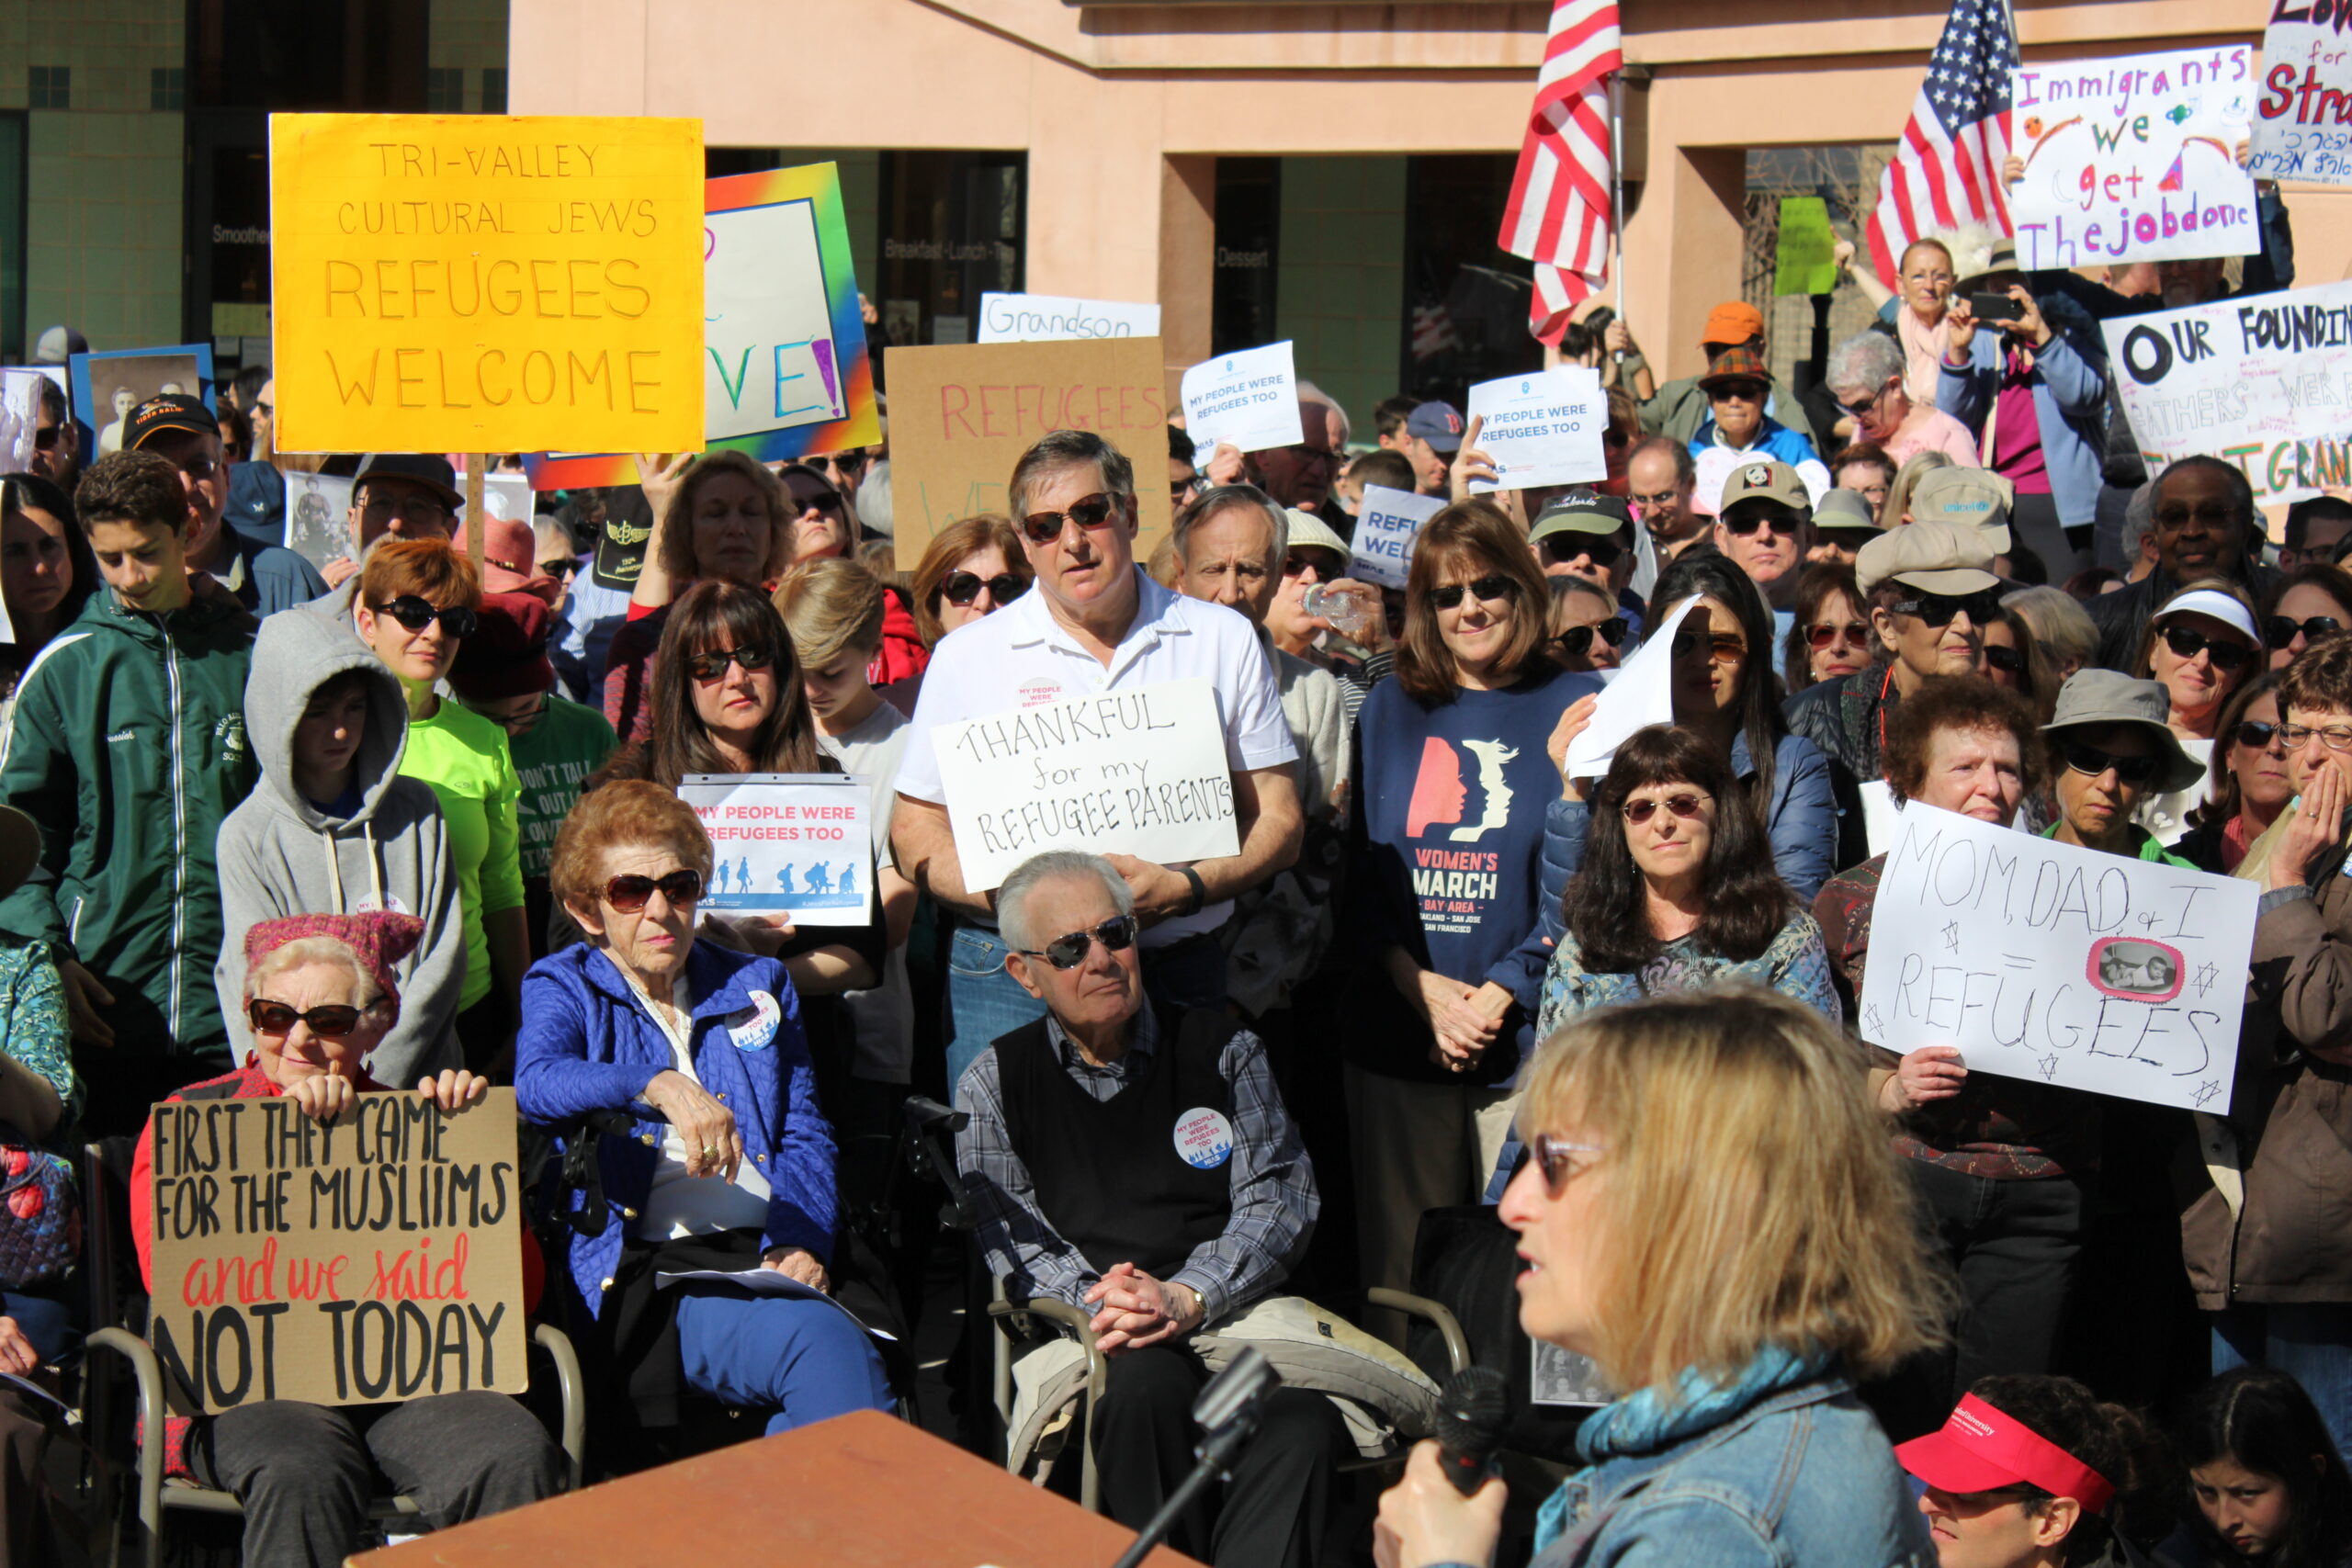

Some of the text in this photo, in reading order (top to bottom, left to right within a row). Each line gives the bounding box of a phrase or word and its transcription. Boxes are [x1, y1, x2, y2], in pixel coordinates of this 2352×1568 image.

[2268, 0, 2352, 37] Lov
[2308, 39, 2346, 65] for
[2018, 49, 2246, 118] Immigrants
[368, 143, 599, 178] TRI-VALLEY
[2078, 164, 2143, 211] get
[338, 198, 657, 238] CULTURAL JEWS
[1217, 247, 1269, 268] Dessert
[324, 258, 651, 320] REFUGEES
[987, 299, 1131, 339] Grandson
[2122, 320, 2217, 385] OUR
[324, 348, 662, 414] WELCOME
[1189, 395, 1204, 408] MY
[1204, 382, 1246, 402] PEOPLE
[1248, 374, 1284, 389] WERE
[942, 384, 1164, 441] REFUGEES
[1197, 391, 1278, 420] REFUGEES TOO
[1494, 408, 1544, 424] PEOPLE
[1548, 403, 1588, 417] WERE
[1481, 422, 1580, 442] REFUGEES TOO
[956, 693, 1176, 762] THANKFUL
[1033, 756, 1149, 791] for my
[695, 806, 855, 820] MY PEOPLE WERE
[978, 775, 1236, 854] REFUGEE PARENTS
[707, 827, 844, 840] REFUGEES TOO
[1415, 848, 1498, 872] WOMEN'S
[1413, 868, 1498, 900] MARCH
[1424, 899, 1445, 912] BAY
[1447, 901, 1475, 913] AREA
[1452, 915, 1464, 923] SAN
[1464, 916, 1482, 924] JOSE
[2160, 886, 2217, 939] I
[1424, 923, 1472, 934] SAN FRANCISCO
[1893, 953, 2222, 1077] REFUGEES
[154, 1095, 451, 1176] FIRST THEY CAME
[1184, 1127, 1220, 1145] REFUGEES
[1188, 1113, 1216, 1127] PEOPLE
[1189, 1124, 1209, 1135] WERE
[1197, 1138, 1212, 1148] TOO
[156, 1175, 220, 1240] FOR
[231, 1171, 292, 1234] THE
[184, 1231, 469, 1308] and we said
[153, 1299, 506, 1415] NOT TODAY
[1964, 1411, 1996, 1437] University
